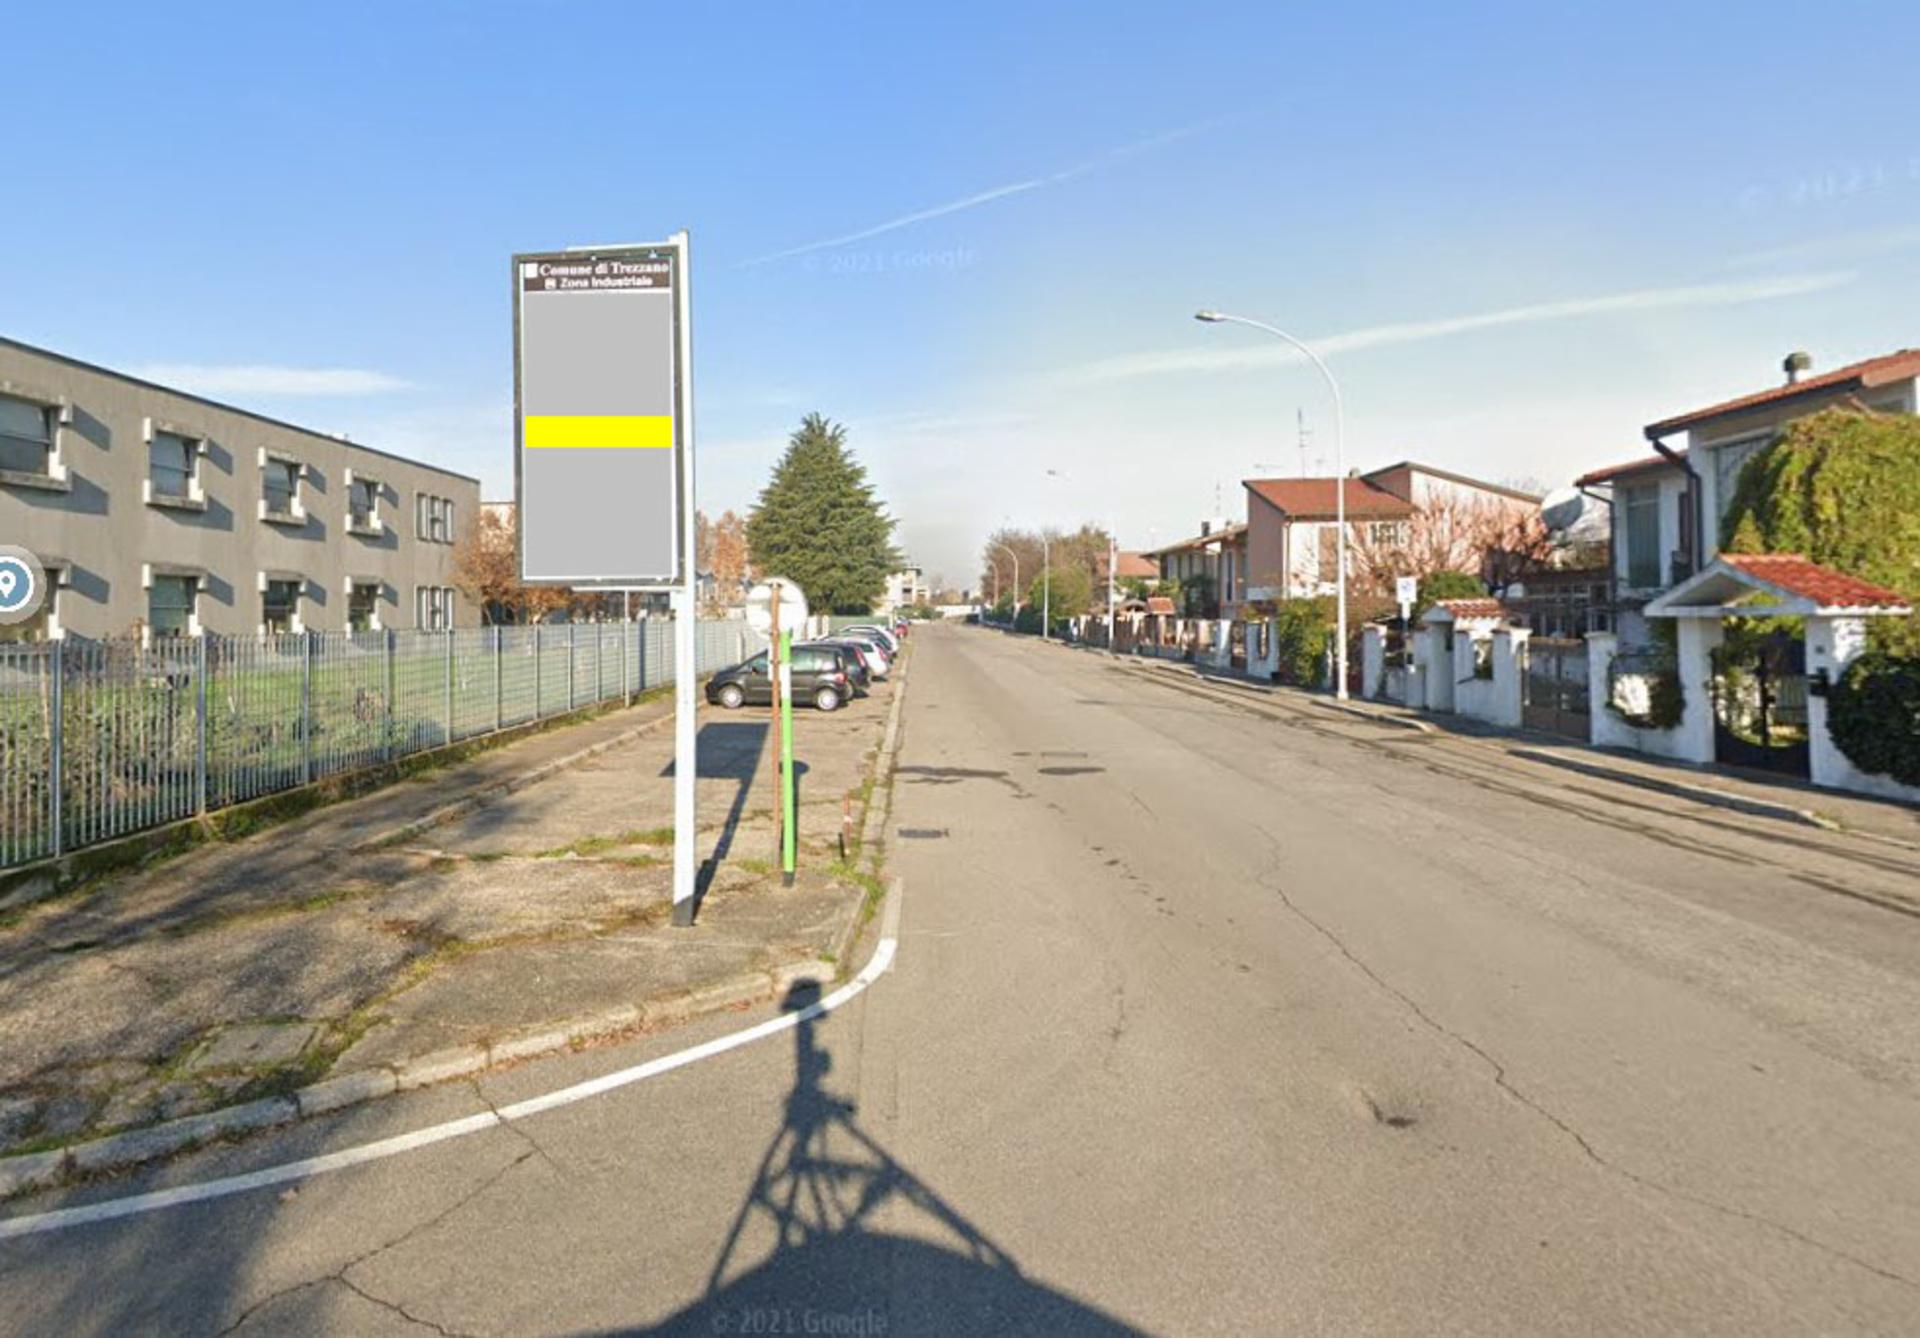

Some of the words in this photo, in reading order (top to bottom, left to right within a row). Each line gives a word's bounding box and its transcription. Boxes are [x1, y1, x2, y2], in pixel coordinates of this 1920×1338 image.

[539, 263, 593, 278] Comune
[595, 262, 608, 274] di
[610, 261, 670, 275] Trezzano
[560, 277, 590, 289] Zona
[592, 275, 655, 288] Industriale
